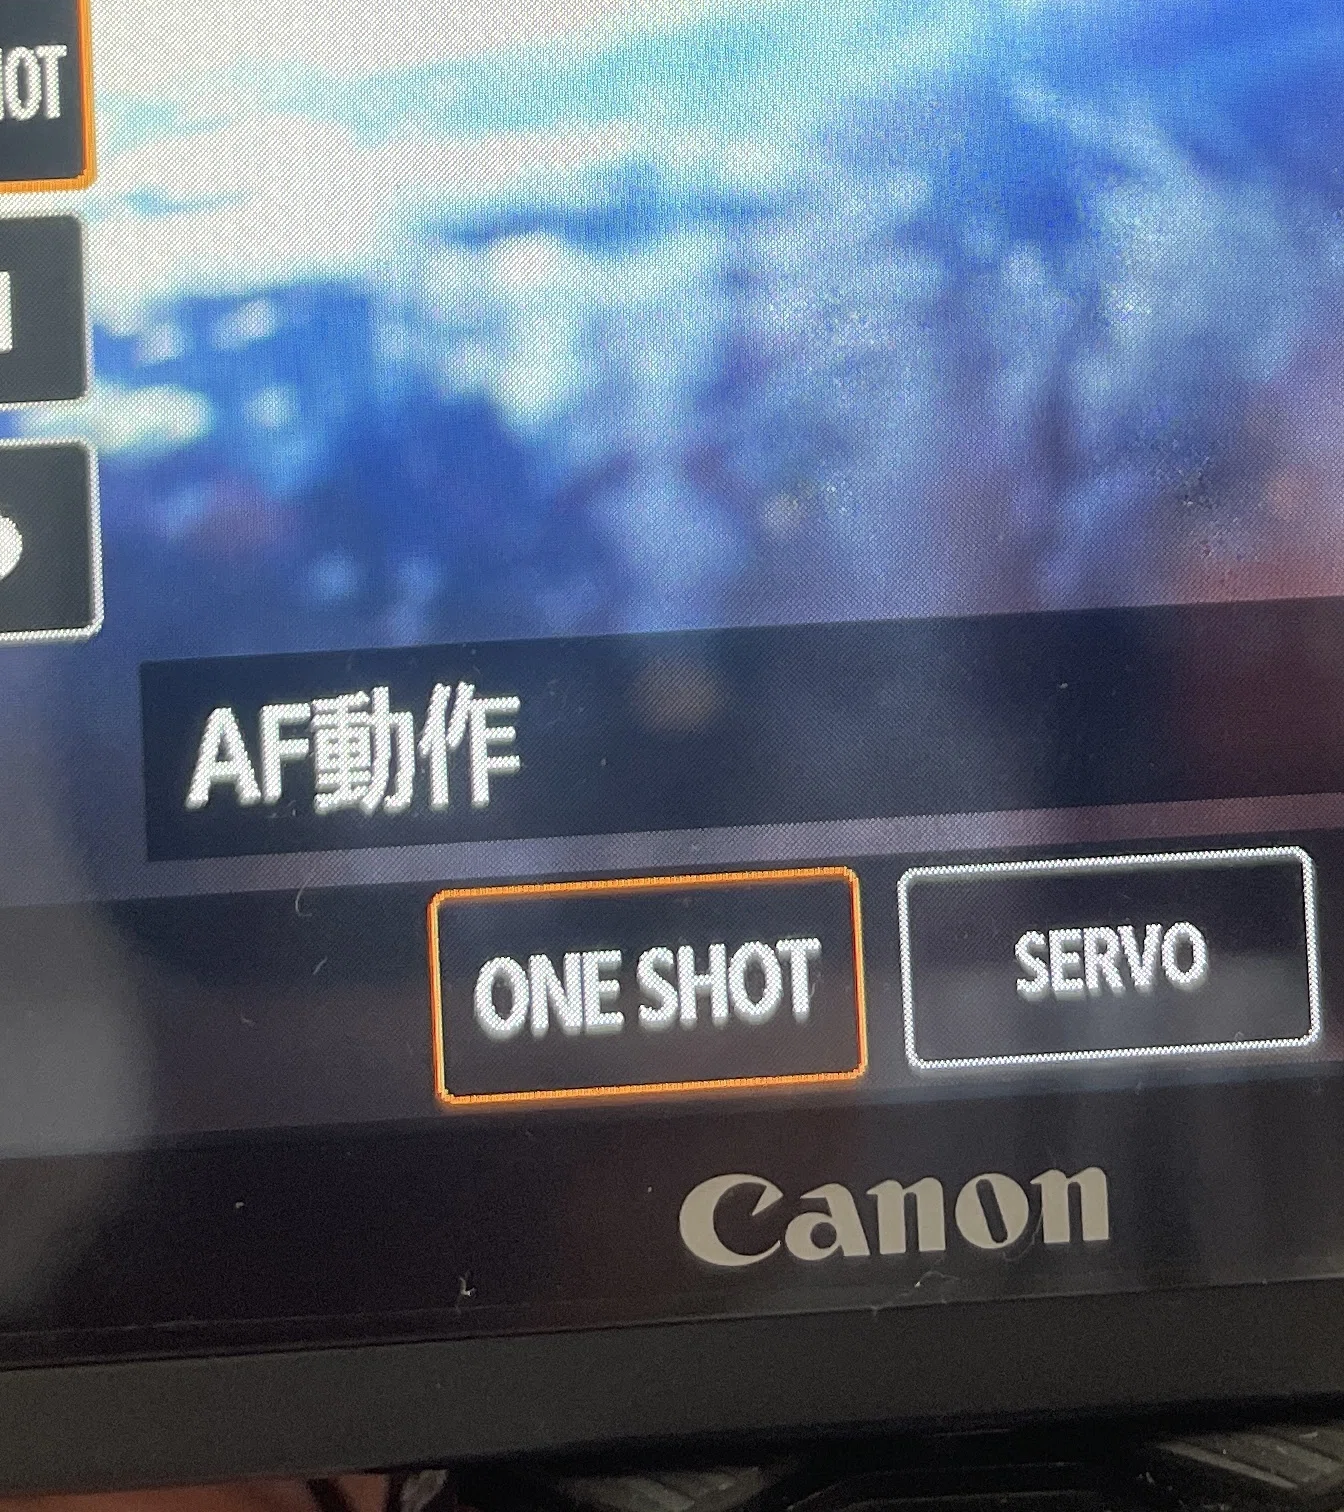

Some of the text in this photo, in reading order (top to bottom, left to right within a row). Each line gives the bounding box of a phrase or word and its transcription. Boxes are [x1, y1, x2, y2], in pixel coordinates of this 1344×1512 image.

[184, 681, 523, 816] AF動作
[474, 937, 822, 1039] ONE SHOT
[1013, 920, 1210, 1001] SERVO
[678, 1166, 1111, 1268] Canon
